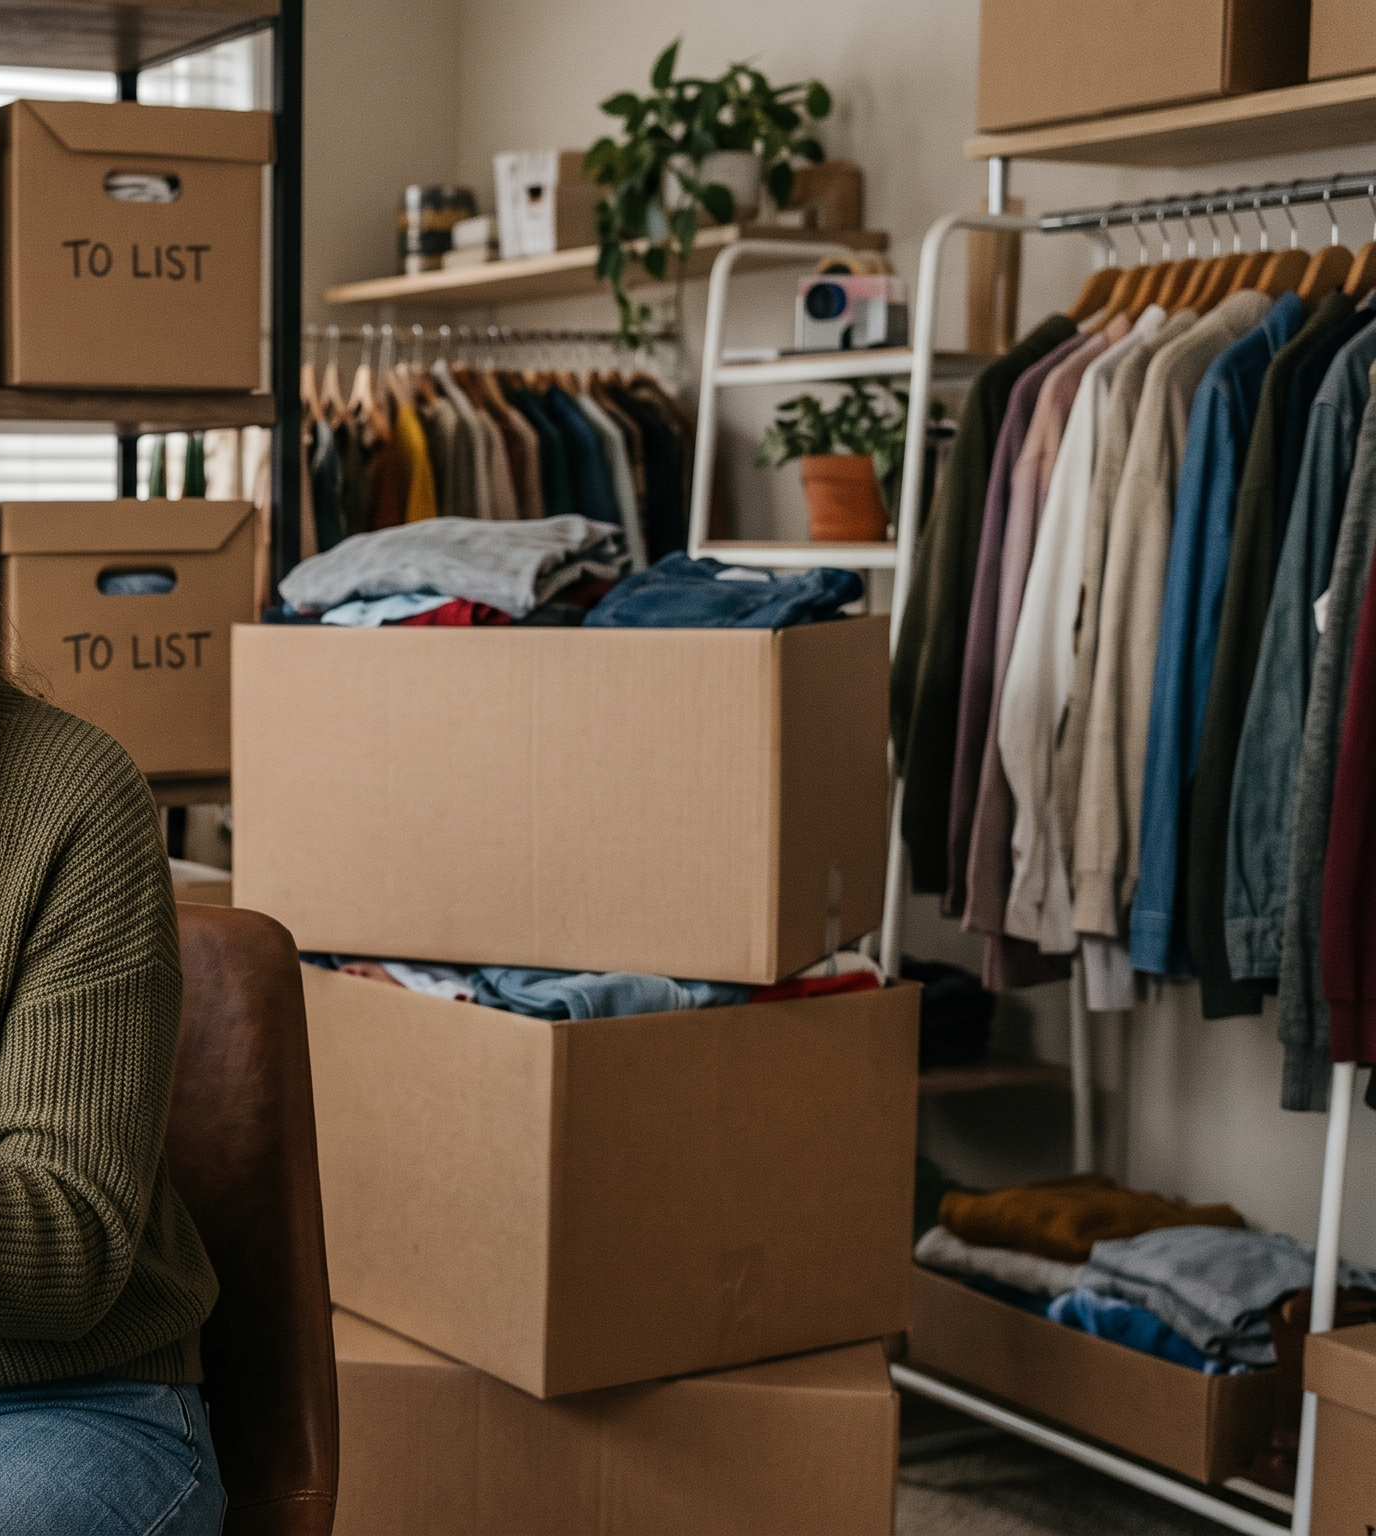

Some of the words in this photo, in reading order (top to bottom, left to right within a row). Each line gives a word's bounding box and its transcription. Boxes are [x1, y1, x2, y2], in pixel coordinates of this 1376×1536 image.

[61, 239, 113, 279] TO
[130, 243, 212, 283] LIST
[63, 632, 114, 673] TO
[131, 631, 211, 671] LIST
